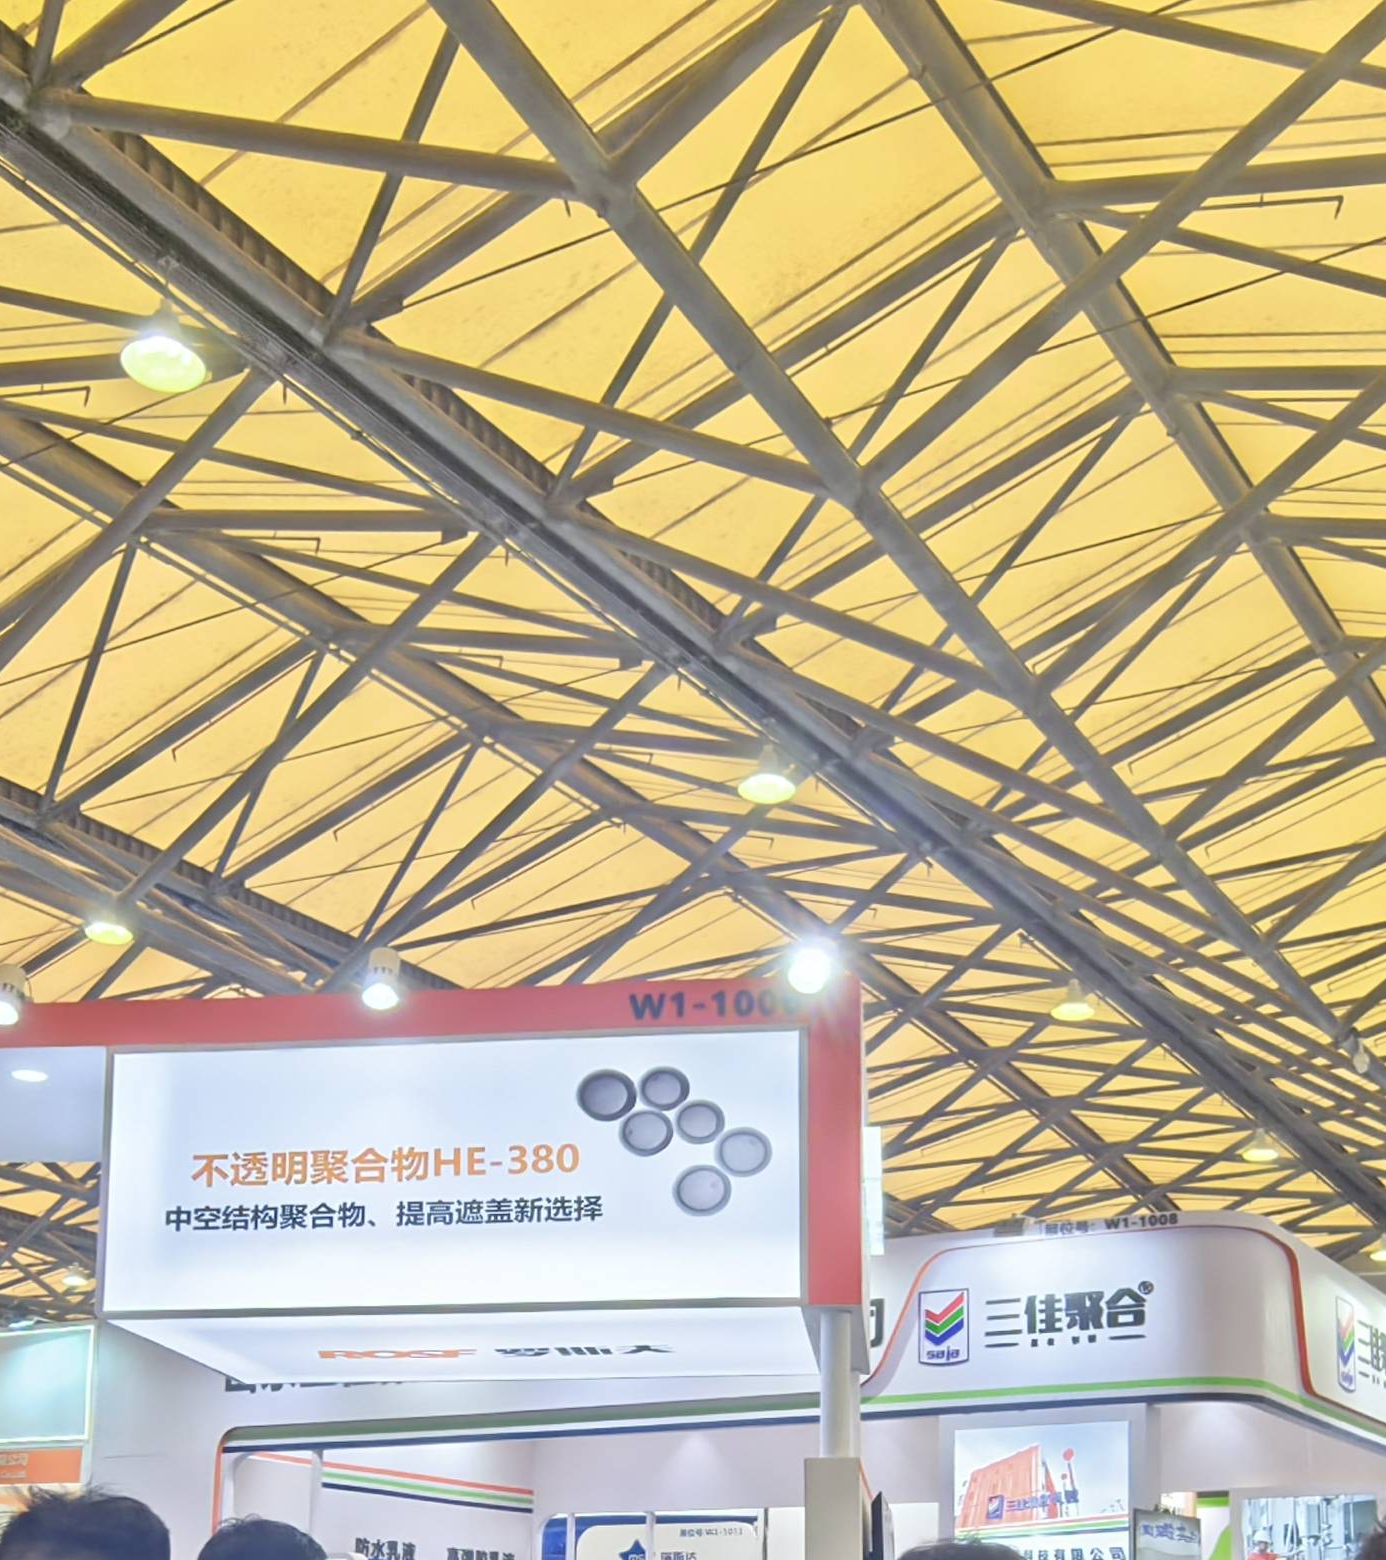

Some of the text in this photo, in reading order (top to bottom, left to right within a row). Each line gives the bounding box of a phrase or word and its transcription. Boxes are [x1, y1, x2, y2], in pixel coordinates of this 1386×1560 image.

[629, 988, 801, 1020] W1-100
[191, 1142, 581, 1189] 不透明聚合物HE-380
[164, 1195, 603, 1234] 中空结构聚合物、提高遮盖新选择
[1105, 1213, 1178, 1231] W1-1008
[984, 1287, 1147, 1337] 三佳聚合
